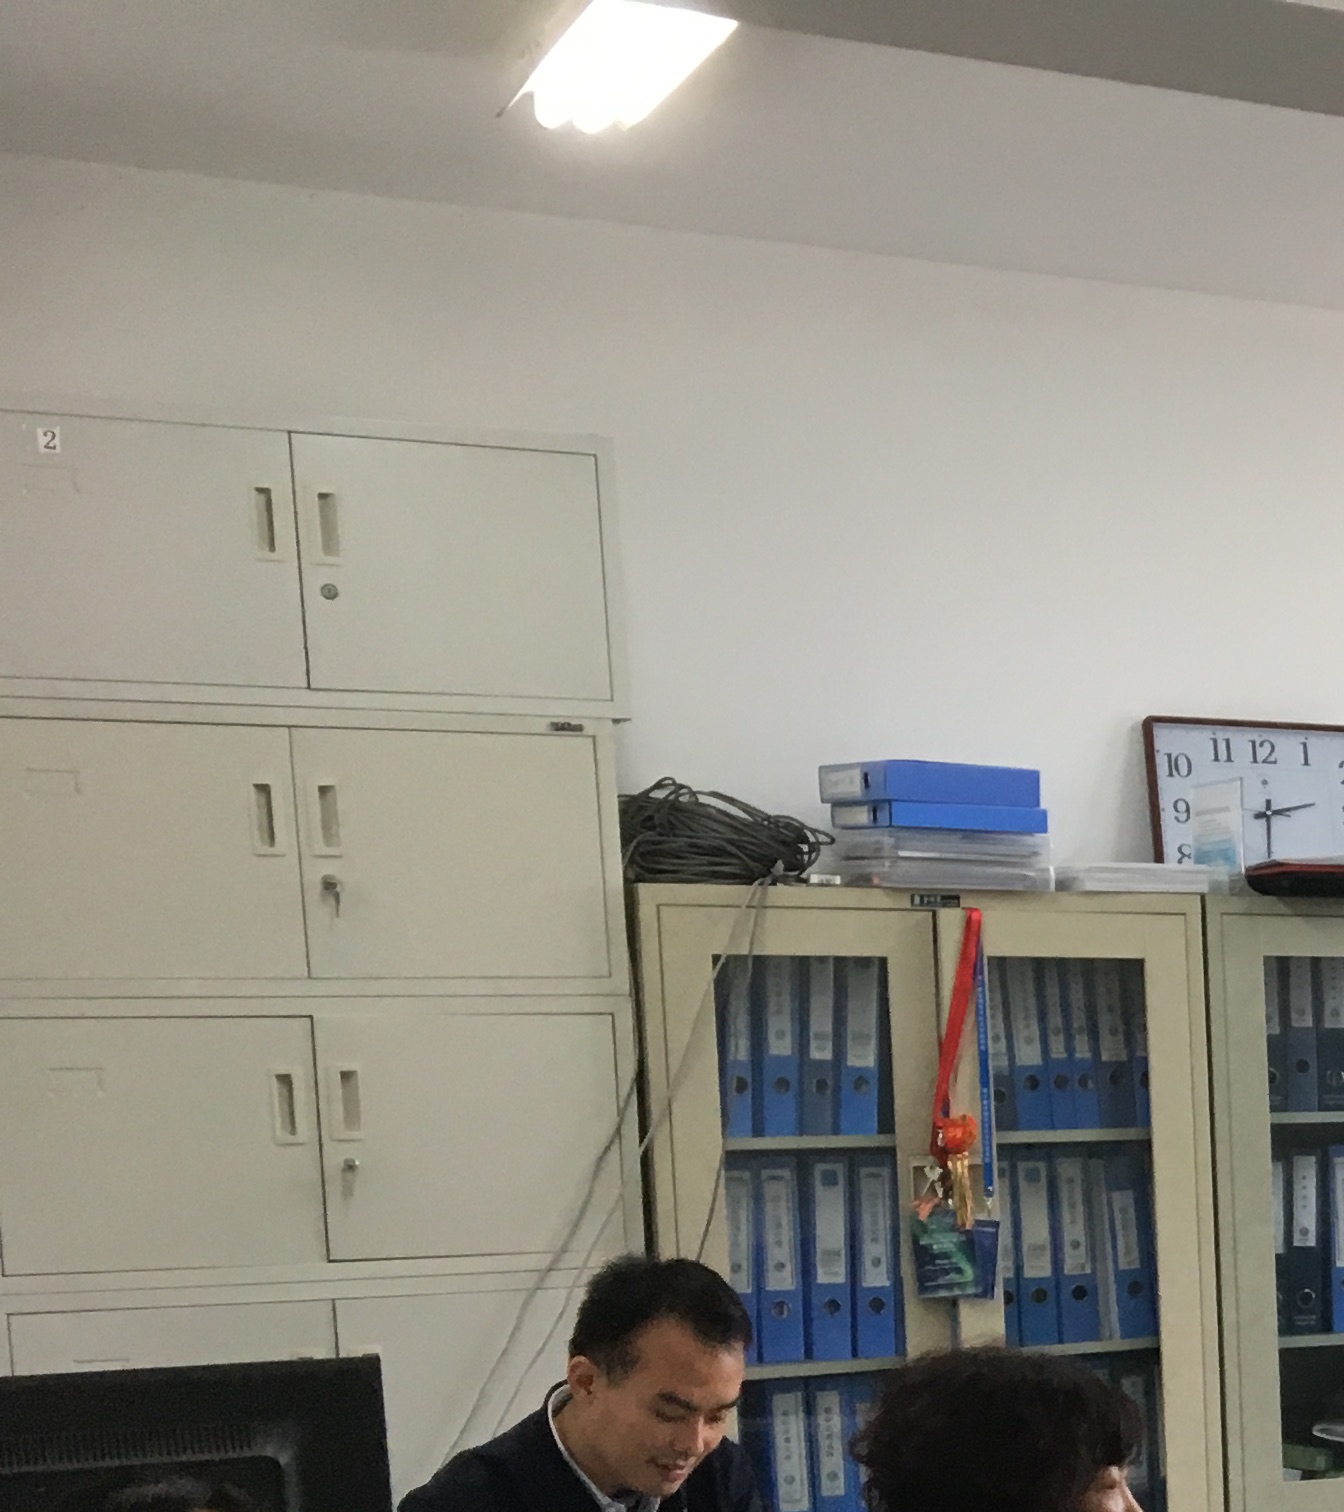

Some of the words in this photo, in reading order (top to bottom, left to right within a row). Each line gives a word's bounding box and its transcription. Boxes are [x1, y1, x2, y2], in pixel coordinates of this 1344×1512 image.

[43, 429, 57, 451] 2
[1210, 737, 1235, 763] 11
[1248, 739, 1278, 765] 12
[1300, 741, 1311, 767] 1
[1164, 752, 1193, 779] 10
[1172, 797, 1191, 824] 9
